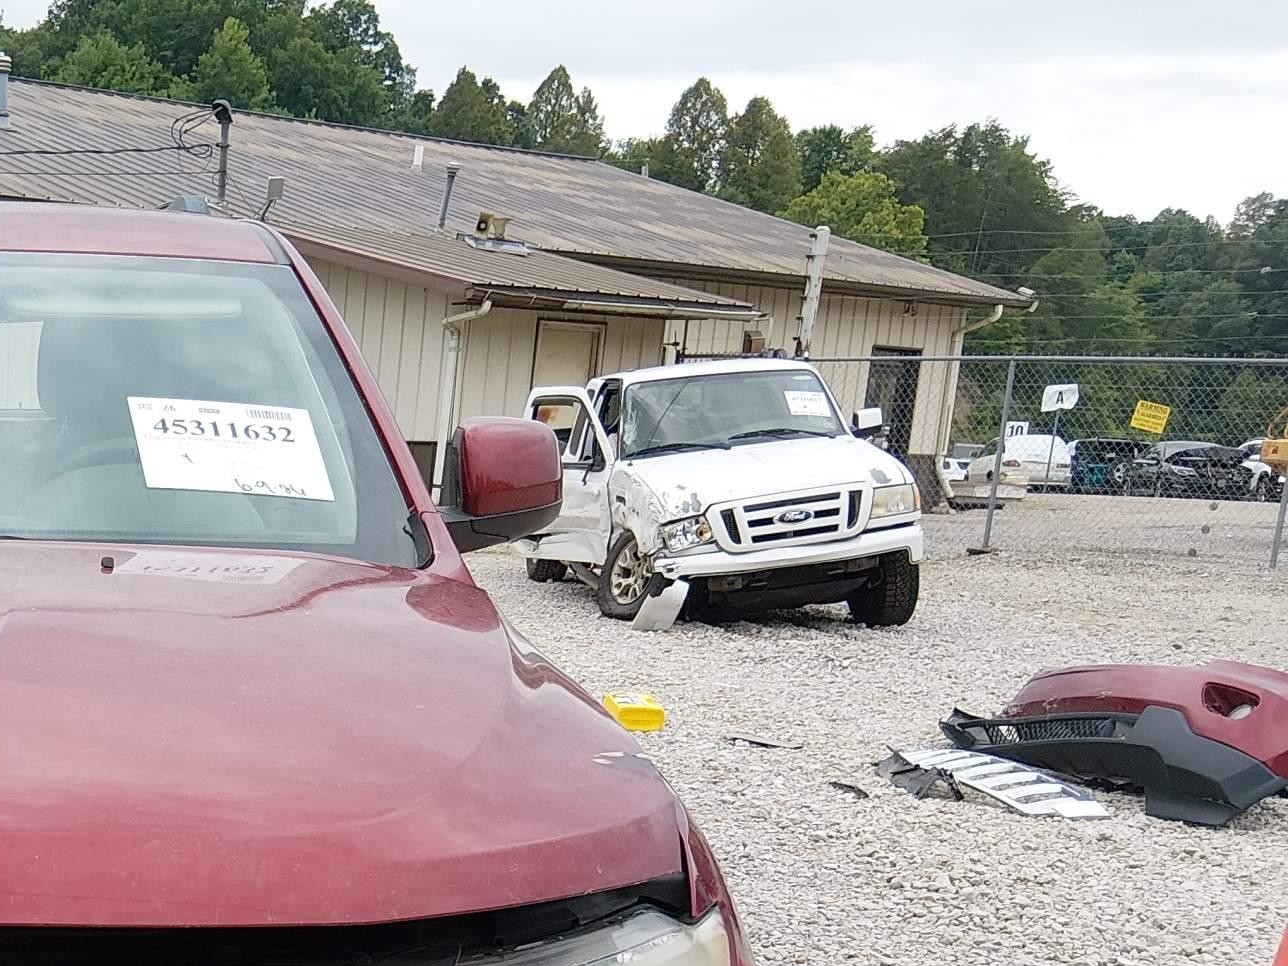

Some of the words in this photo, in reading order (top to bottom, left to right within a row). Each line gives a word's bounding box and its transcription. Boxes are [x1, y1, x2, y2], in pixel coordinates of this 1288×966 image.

[1056, 391, 1064, 405] A
[152, 417, 295, 443] 45311632
[784, 511, 806, 522] Ford
